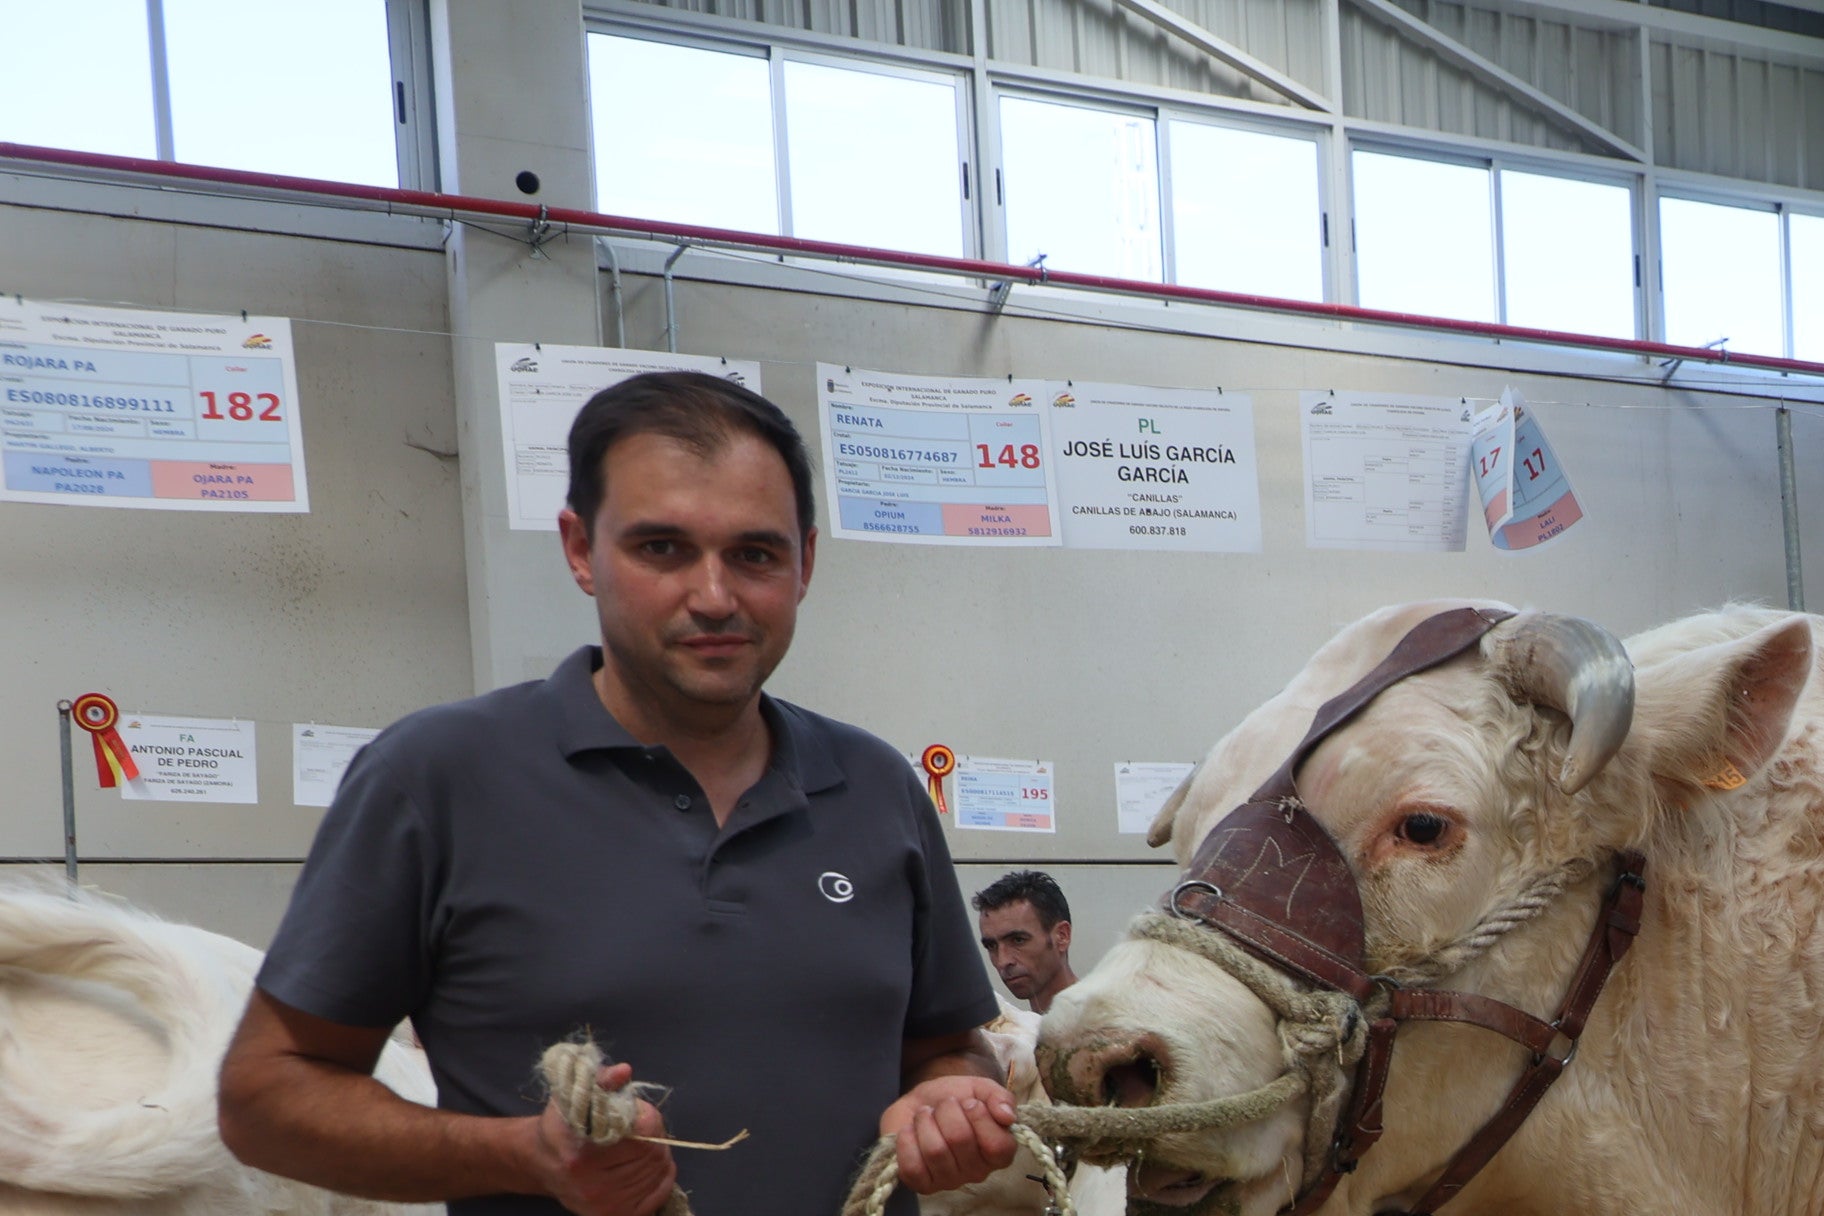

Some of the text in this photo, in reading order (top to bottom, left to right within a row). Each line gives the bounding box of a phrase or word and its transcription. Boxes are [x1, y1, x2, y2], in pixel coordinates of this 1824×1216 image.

[3, 353, 97, 373] ROJARA PA
[7, 388, 176, 413] ES080816899111
[199, 391, 283, 422] 182
[836, 414, 884, 430] RENATA
[1137, 417, 1162, 435] PL
[839, 443, 958, 464] ES050816774687
[976, 443, 1041, 470] 148
[1063, 438, 1237, 465] JOSÉ LUÍS GARCÍA
[1479, 446, 1502, 478] 17
[1523, 447, 1546, 482] 17
[31, 465, 125, 481] NAPOLEON PA
[236, 475, 254, 486] PA
[1117, 464, 1189, 485] GARCÍA
[874, 509, 906, 521] OPIUM
[980, 514, 1012, 525] MILKA
[1072, 505, 1238, 521] CANILLAS DE ABAJO (SALAMANCA)
[1129, 525, 1187, 537] 600.837.818
[179, 733, 196, 743] FA
[131, 744, 244, 759] ANTONIO PASCUAL
[158, 757, 218, 769] DE PEDRO
[1022, 787, 1048, 801] 195
